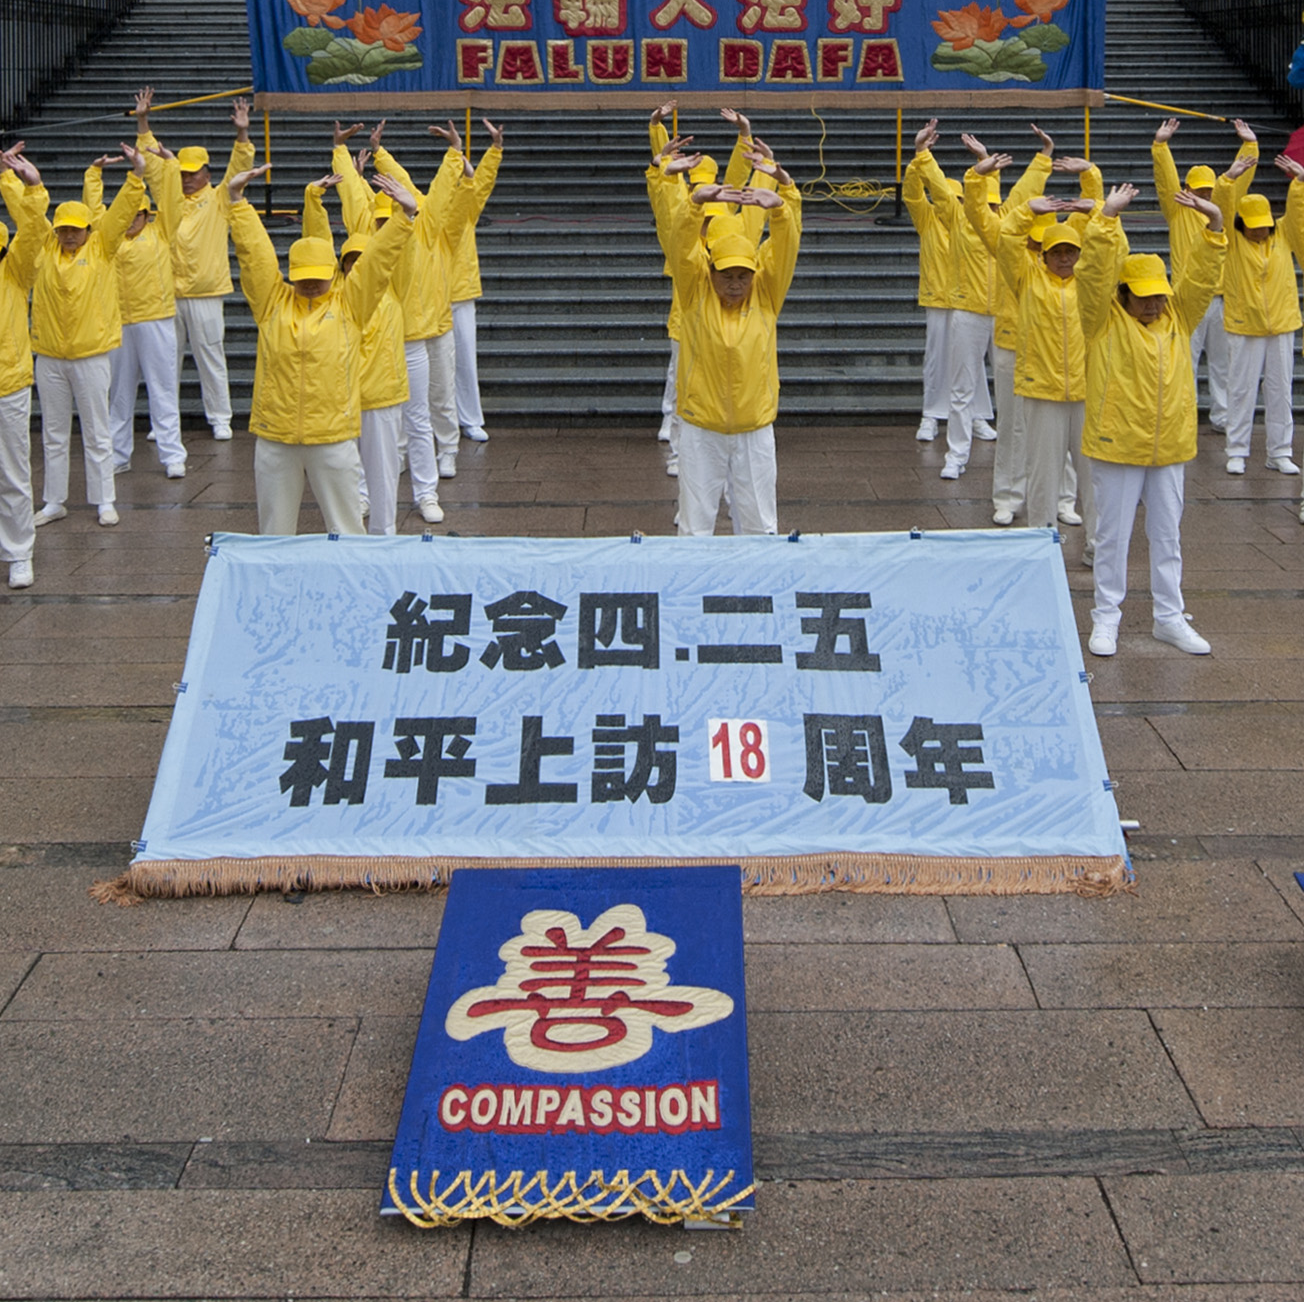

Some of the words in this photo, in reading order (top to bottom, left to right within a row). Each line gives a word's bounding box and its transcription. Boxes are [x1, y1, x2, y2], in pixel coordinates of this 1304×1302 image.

[456, 38, 688, 85] FALUN
[719, 38, 904, 85] DAFA
[458, 918, 702, 1059] 善
[441, 1084, 717, 1128] COMPASSION
